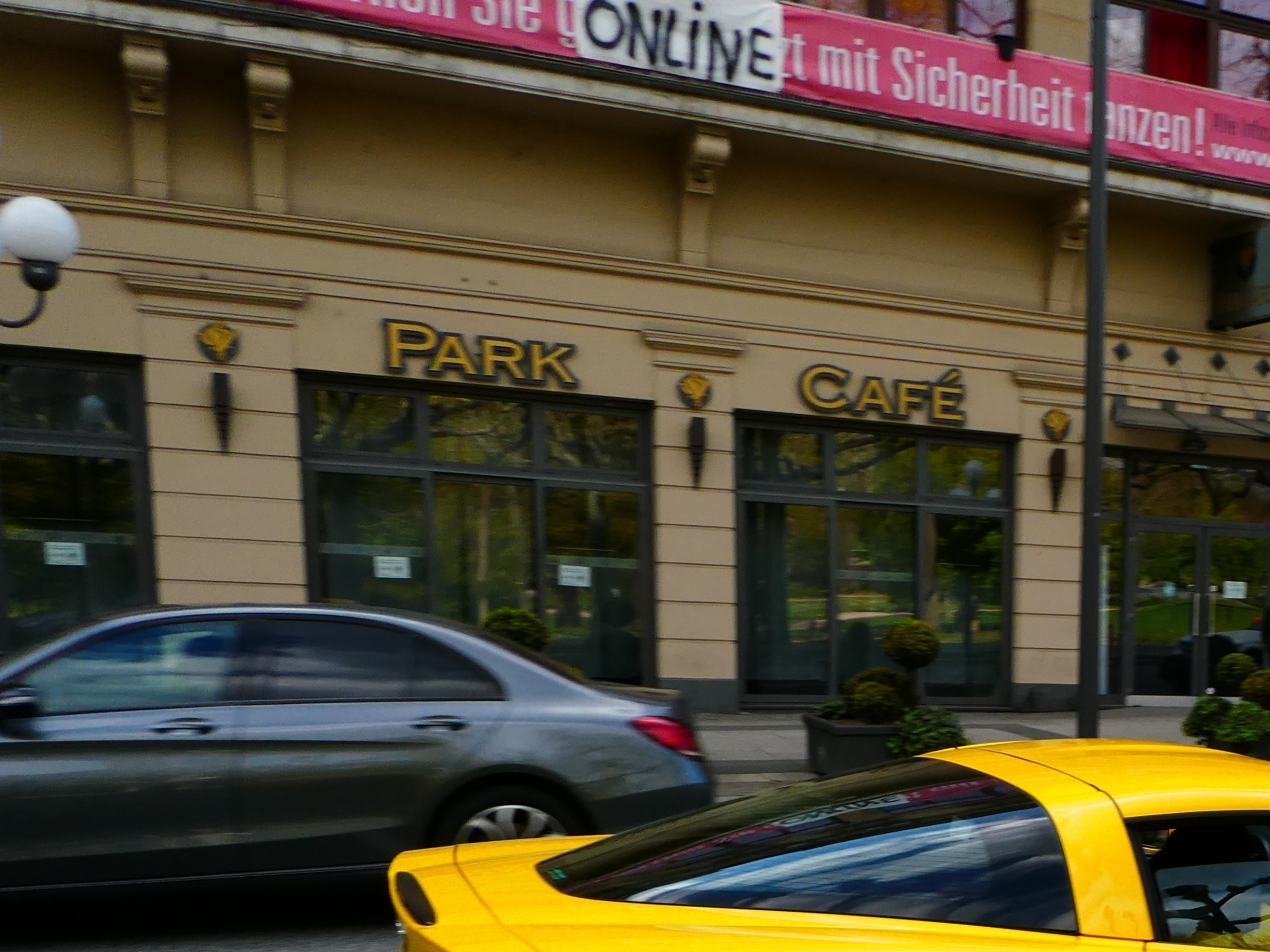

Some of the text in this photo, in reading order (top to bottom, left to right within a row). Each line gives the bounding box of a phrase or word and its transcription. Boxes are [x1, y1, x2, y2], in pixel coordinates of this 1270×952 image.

[818, 39, 881, 95] mit
[890, 46, 1075, 132] Sicherheit
[380, 317, 579, 388] PARK
[798, 363, 966, 425] CAFÉ
